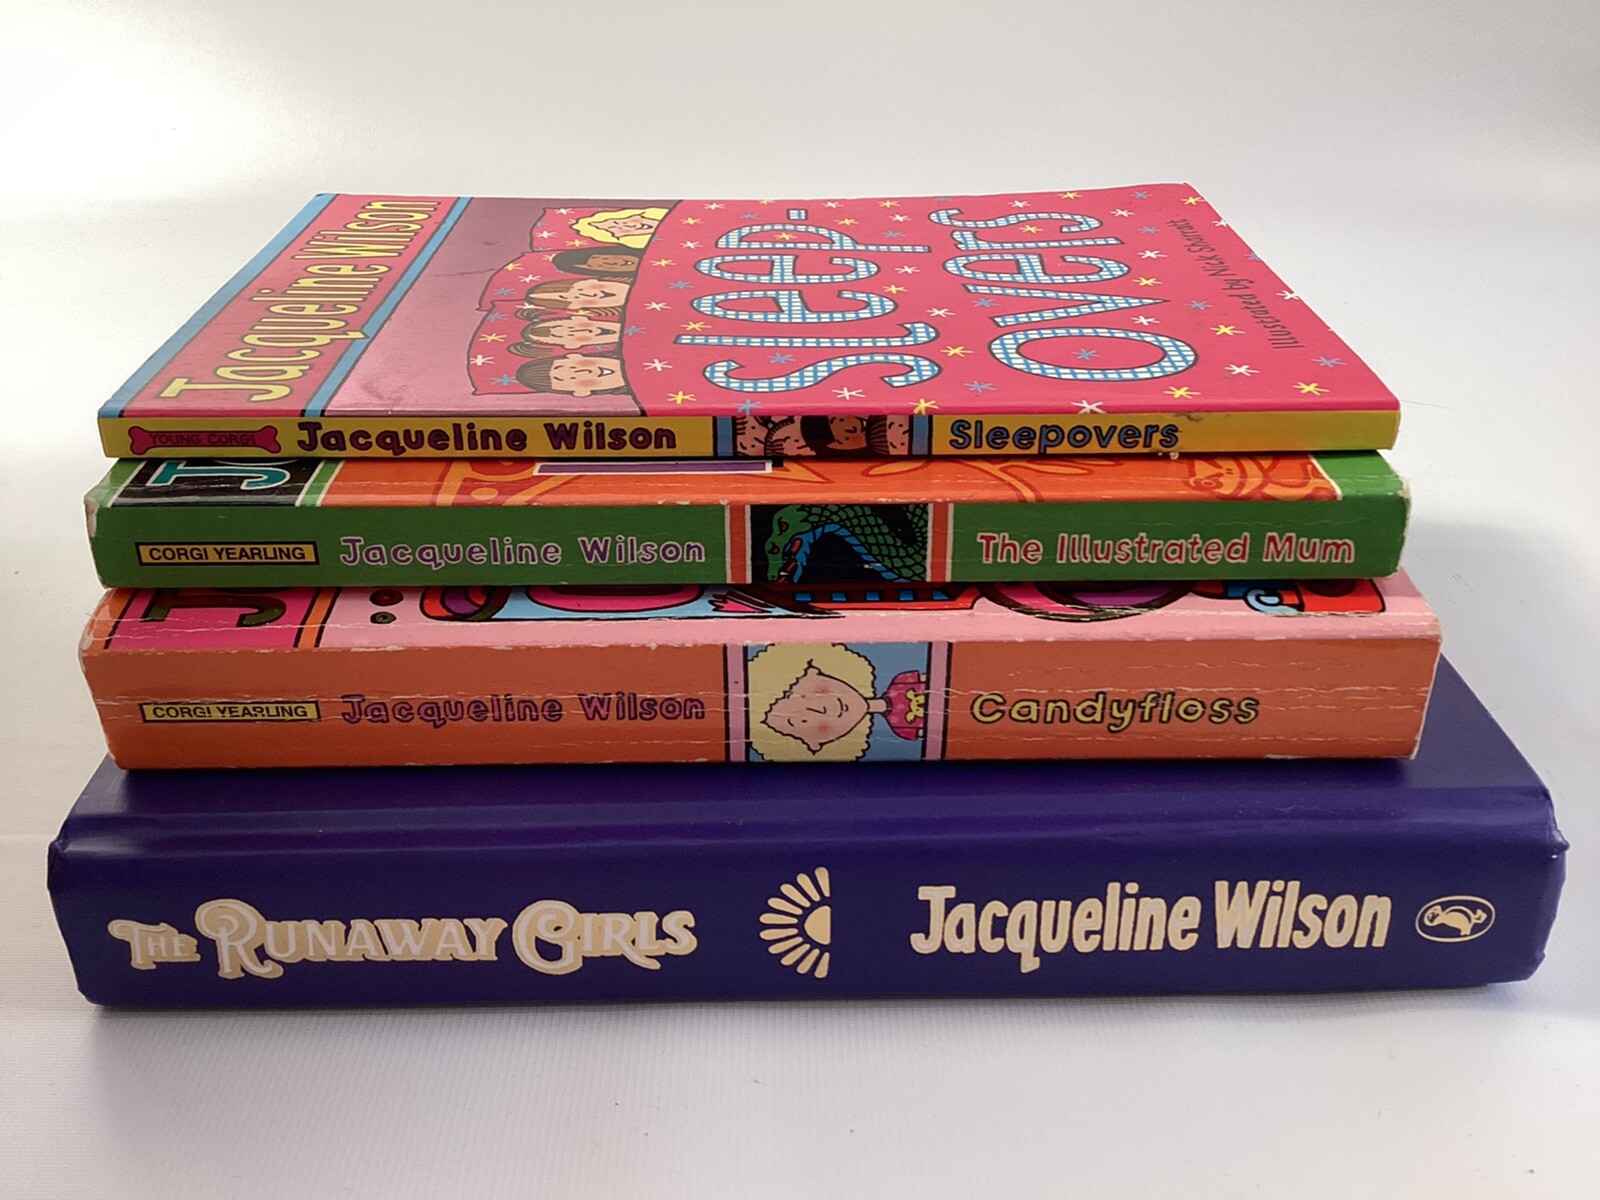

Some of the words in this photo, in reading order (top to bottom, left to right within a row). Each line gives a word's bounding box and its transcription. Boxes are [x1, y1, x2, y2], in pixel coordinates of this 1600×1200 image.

[1166, 218, 1216, 253] Sharratt
[1195, 253, 1238, 277] Nick
[158, 263, 390, 402] Jacqueline
[293, 199, 441, 259] Wilson
[673, 207, 943, 393] Sleep-
[1220, 278, 1254, 291] by
[1228, 293, 1305, 350] Illustrated
[149, 433, 202, 445] YOUNG
[207, 433, 256, 445] CORGI
[297, 421, 526, 456] Jacqueline
[544, 420, 677, 452] Wilson
[949, 420, 1180, 454] Sleepovers
[149, 547, 209, 561] CORGI
[212, 547, 306, 560] YEARLING
[339, 535, 564, 571] Jacqueline
[577, 535, 707, 564] Wilson
[976, 532, 1043, 565] The
[1057, 533, 1251, 564] Illustrated
[1261, 532, 1356, 564] Mum
[152, 707, 212, 719] CORGI
[215, 706, 308, 718] YEARLING
[341, 694, 564, 729] Jacqueline
[577, 692, 706, 722] Wilson
[970, 692, 1261, 733] Candyfloss
[909, 882, 1202, 974] Jacqueline
[1214, 880, 1393, 950] Wilson
